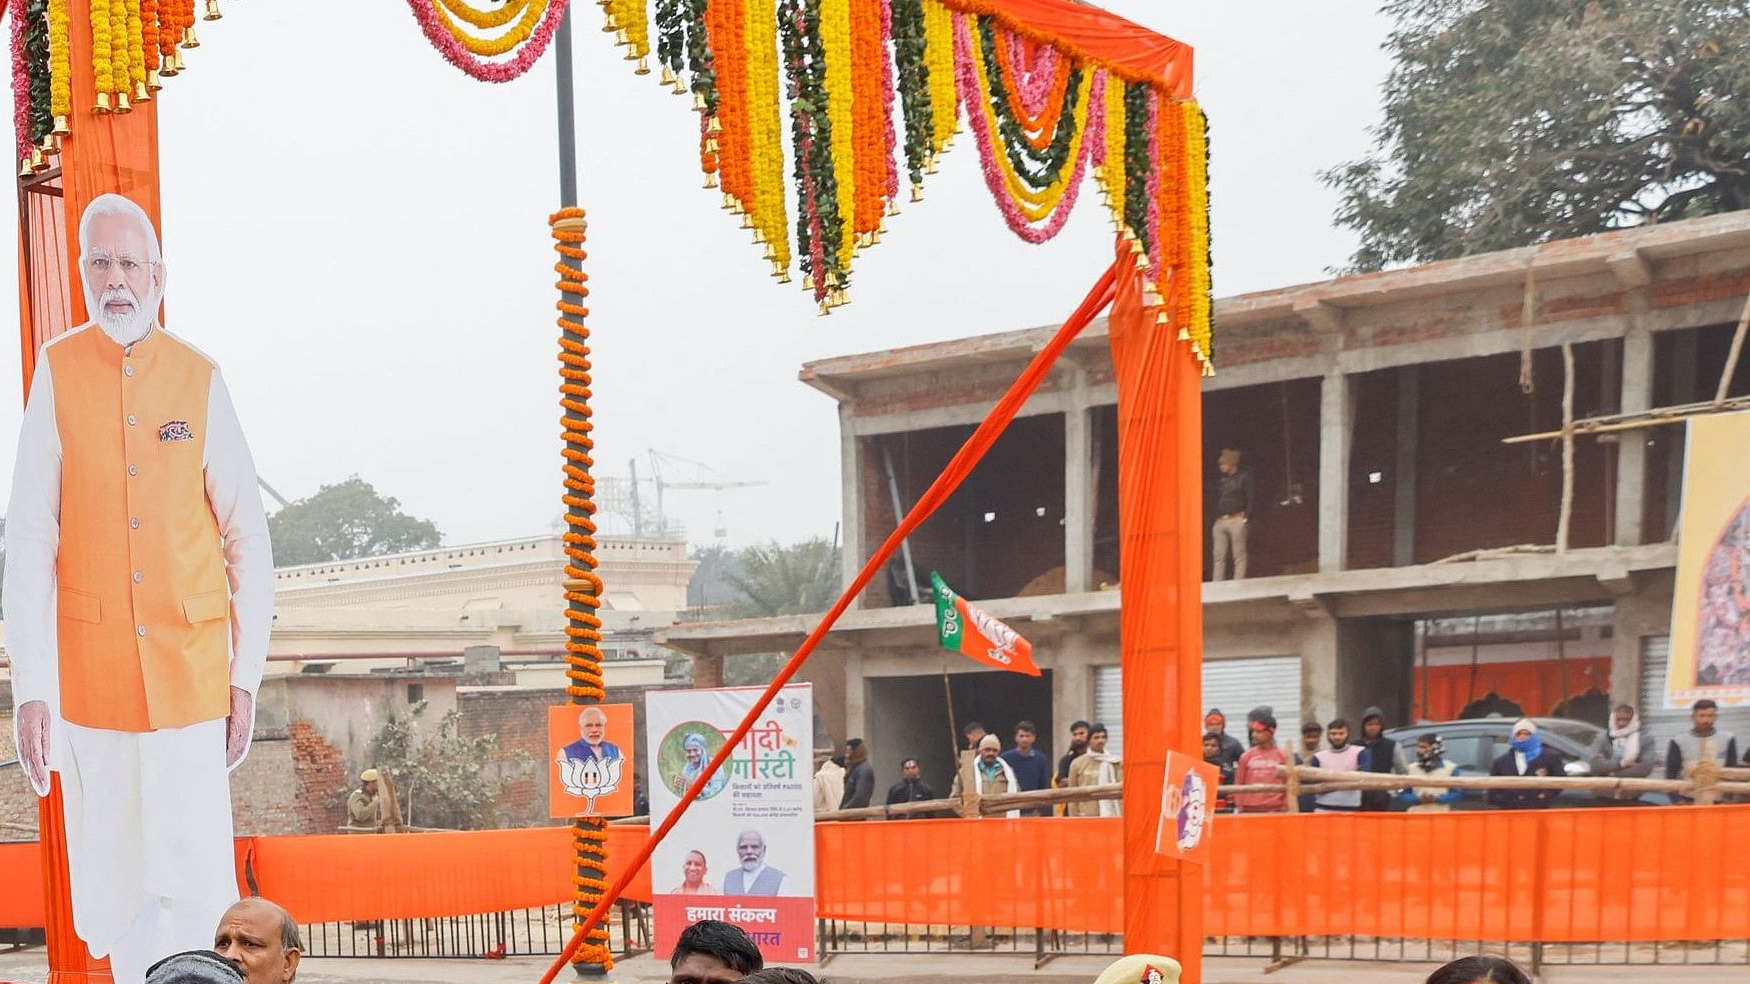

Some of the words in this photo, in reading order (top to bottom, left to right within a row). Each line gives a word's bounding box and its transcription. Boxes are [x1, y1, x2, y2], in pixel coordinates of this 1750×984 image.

[731, 750, 795, 779] गारंटी
[686, 906, 725, 922] हमारा
[728, 904, 777, 924] संकल्प
